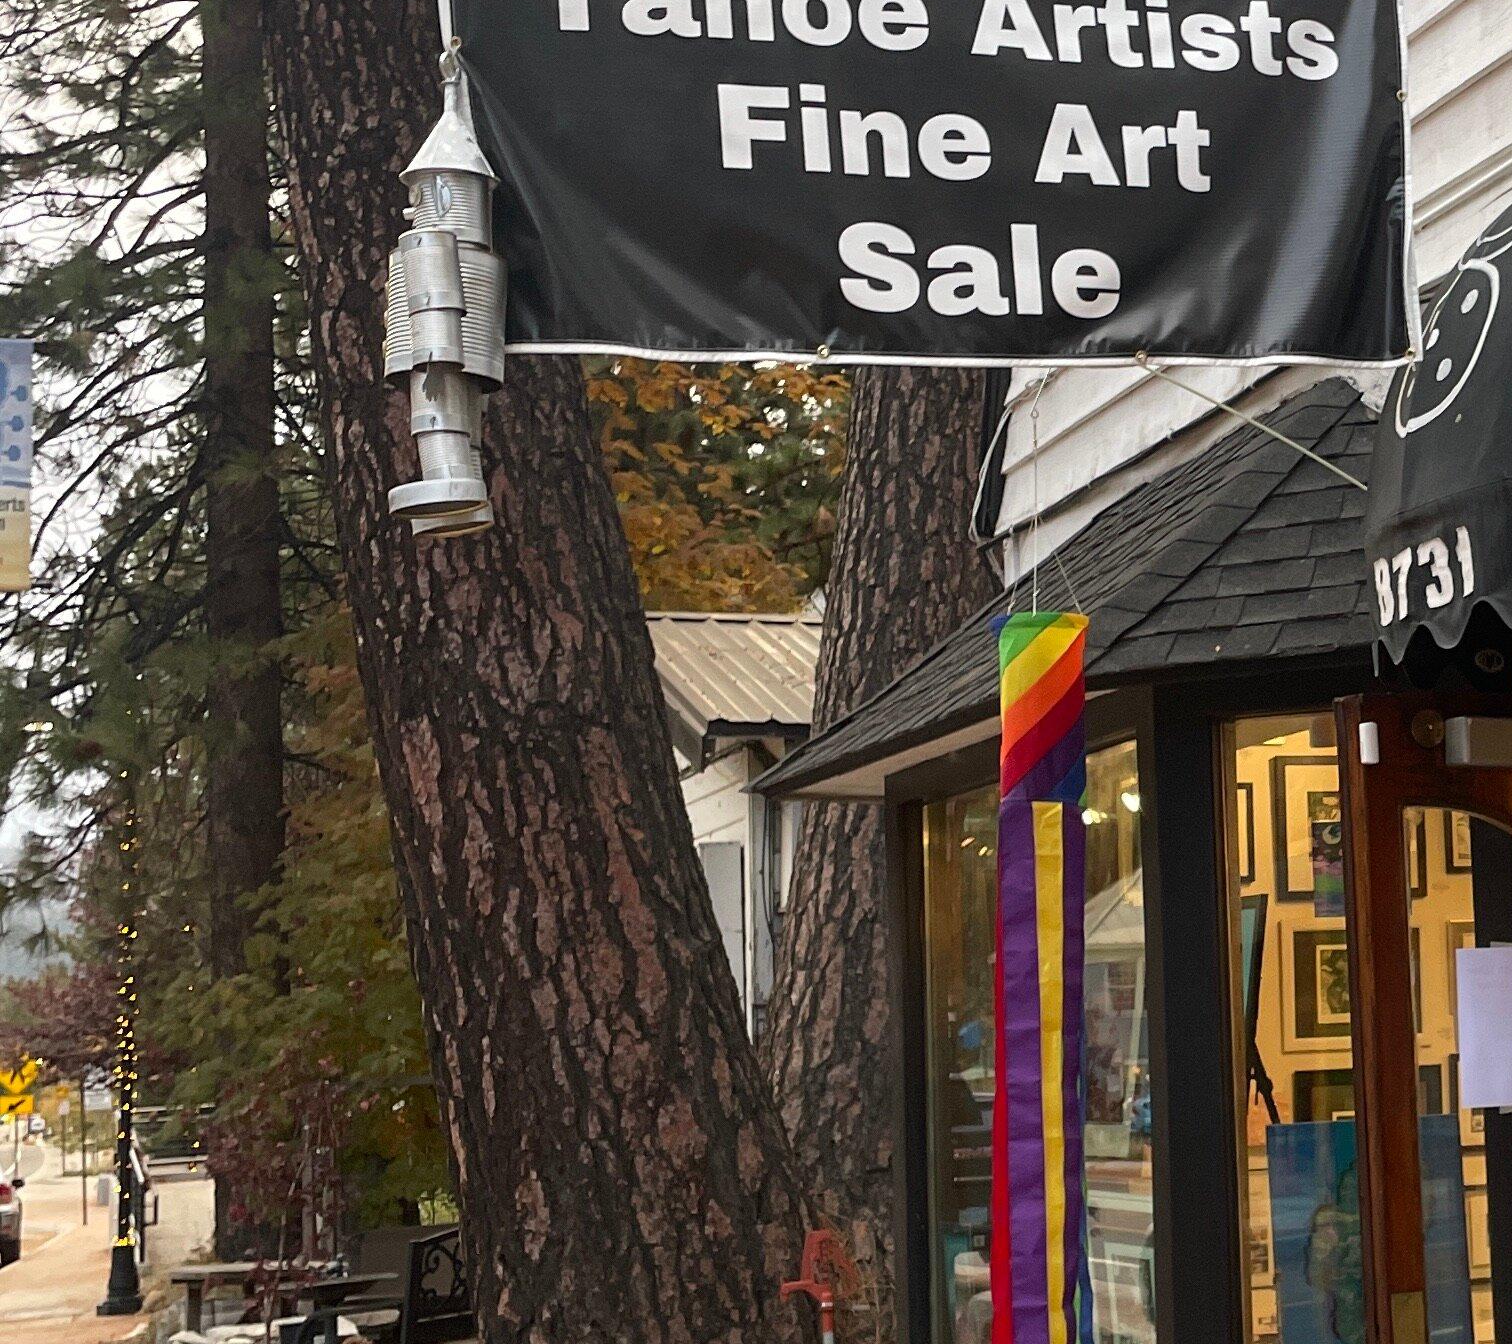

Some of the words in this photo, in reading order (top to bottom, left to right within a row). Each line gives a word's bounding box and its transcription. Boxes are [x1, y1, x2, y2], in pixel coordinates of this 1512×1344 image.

[717, 83, 991, 181] Fine
[1034, 103, 1212, 192] Art
[837, 221, 1121, 318] Sale
[1373, 525, 1475, 627] 8731
